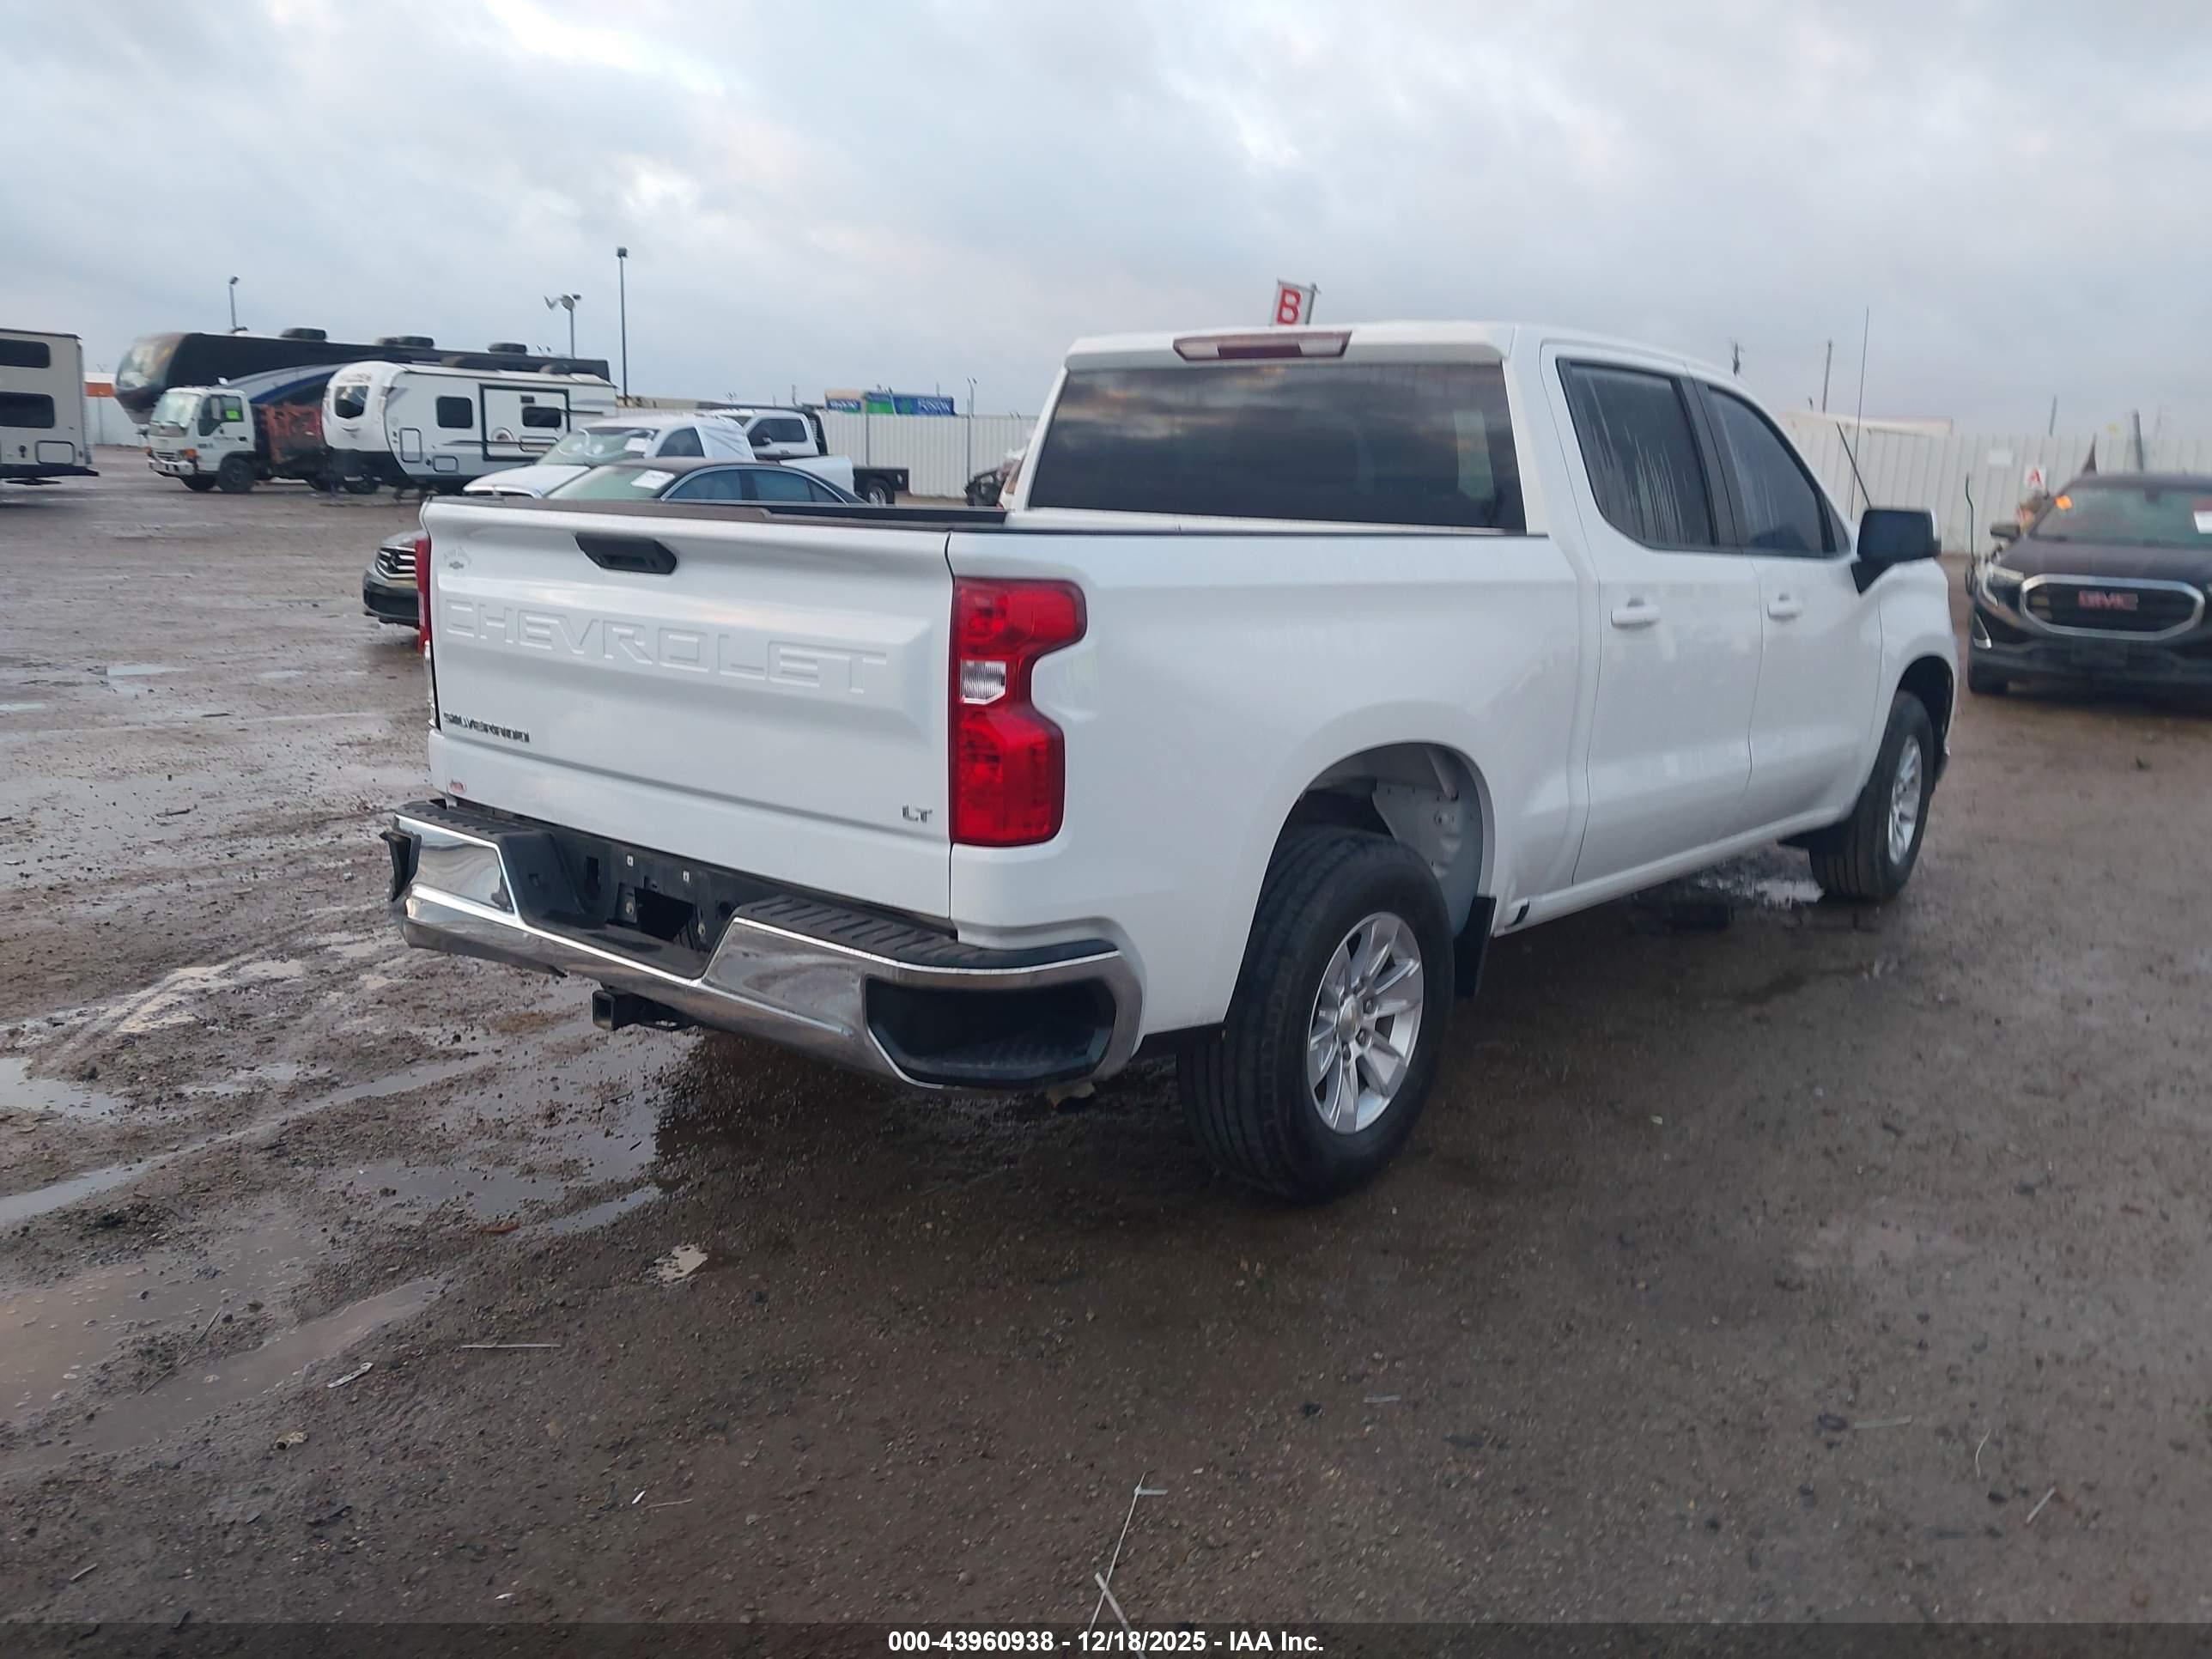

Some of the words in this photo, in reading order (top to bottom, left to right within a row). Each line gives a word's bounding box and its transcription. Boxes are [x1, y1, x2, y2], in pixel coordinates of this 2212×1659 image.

[1277, 288, 1301, 325] B
[2027, 466, 2043, 489] A
[2078, 589, 2139, 611] GMC
[444, 602, 888, 695] CHEVROLET
[902, 805, 933, 824] LT
